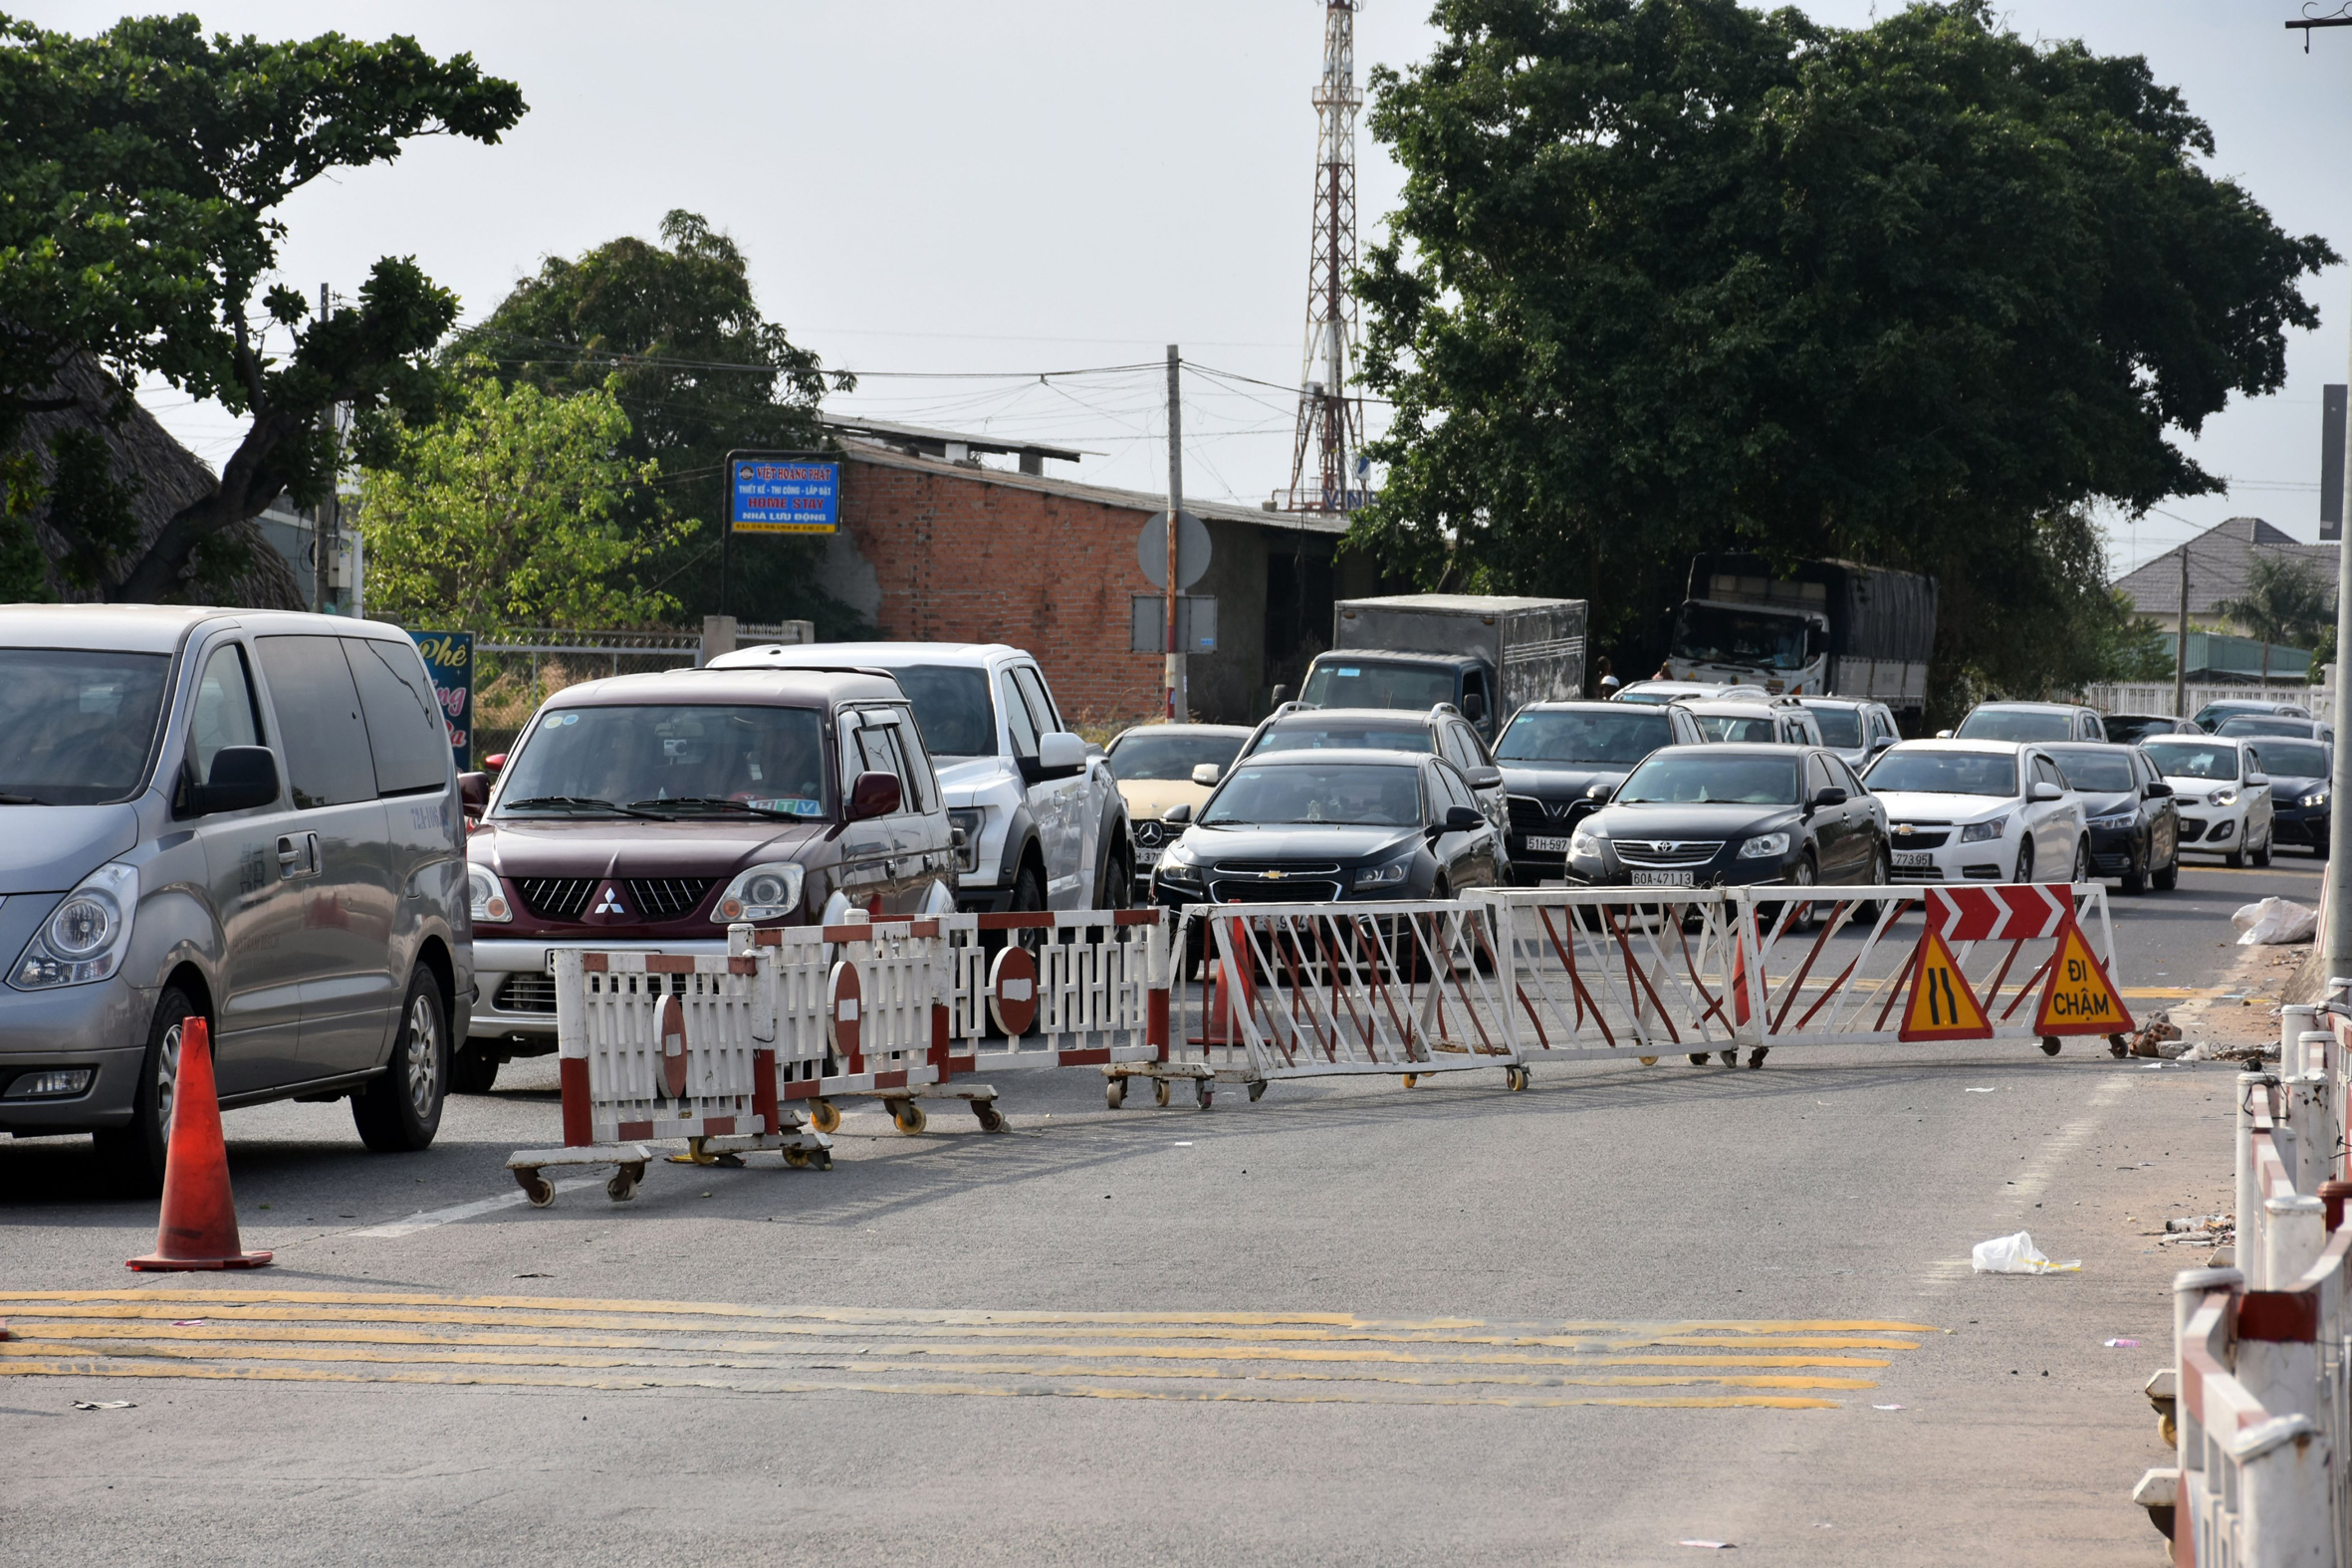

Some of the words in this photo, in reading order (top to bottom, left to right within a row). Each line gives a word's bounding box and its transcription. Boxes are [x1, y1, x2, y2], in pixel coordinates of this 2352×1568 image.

[757, 463, 777, 483] VIỆT
[771, 485, 782, 495] THI
[783, 485, 801, 495] CÔNG
[748, 497, 788, 510] HOME
[792, 498, 824, 510] STAY
[742, 511, 767, 520] NHÀ
[769, 512, 792, 521] LƯU
[794, 512, 826, 522] ĐỘNG
[418, 635, 467, 667] Phê
[431, 679, 467, 717] ng
[1528, 837, 1567, 850] 51H-597
[1633, 872, 1692, 886] 60A-471.13
[2068, 959, 2087, 982] ĐI
[2053, 987, 2110, 1021] CHẬM
